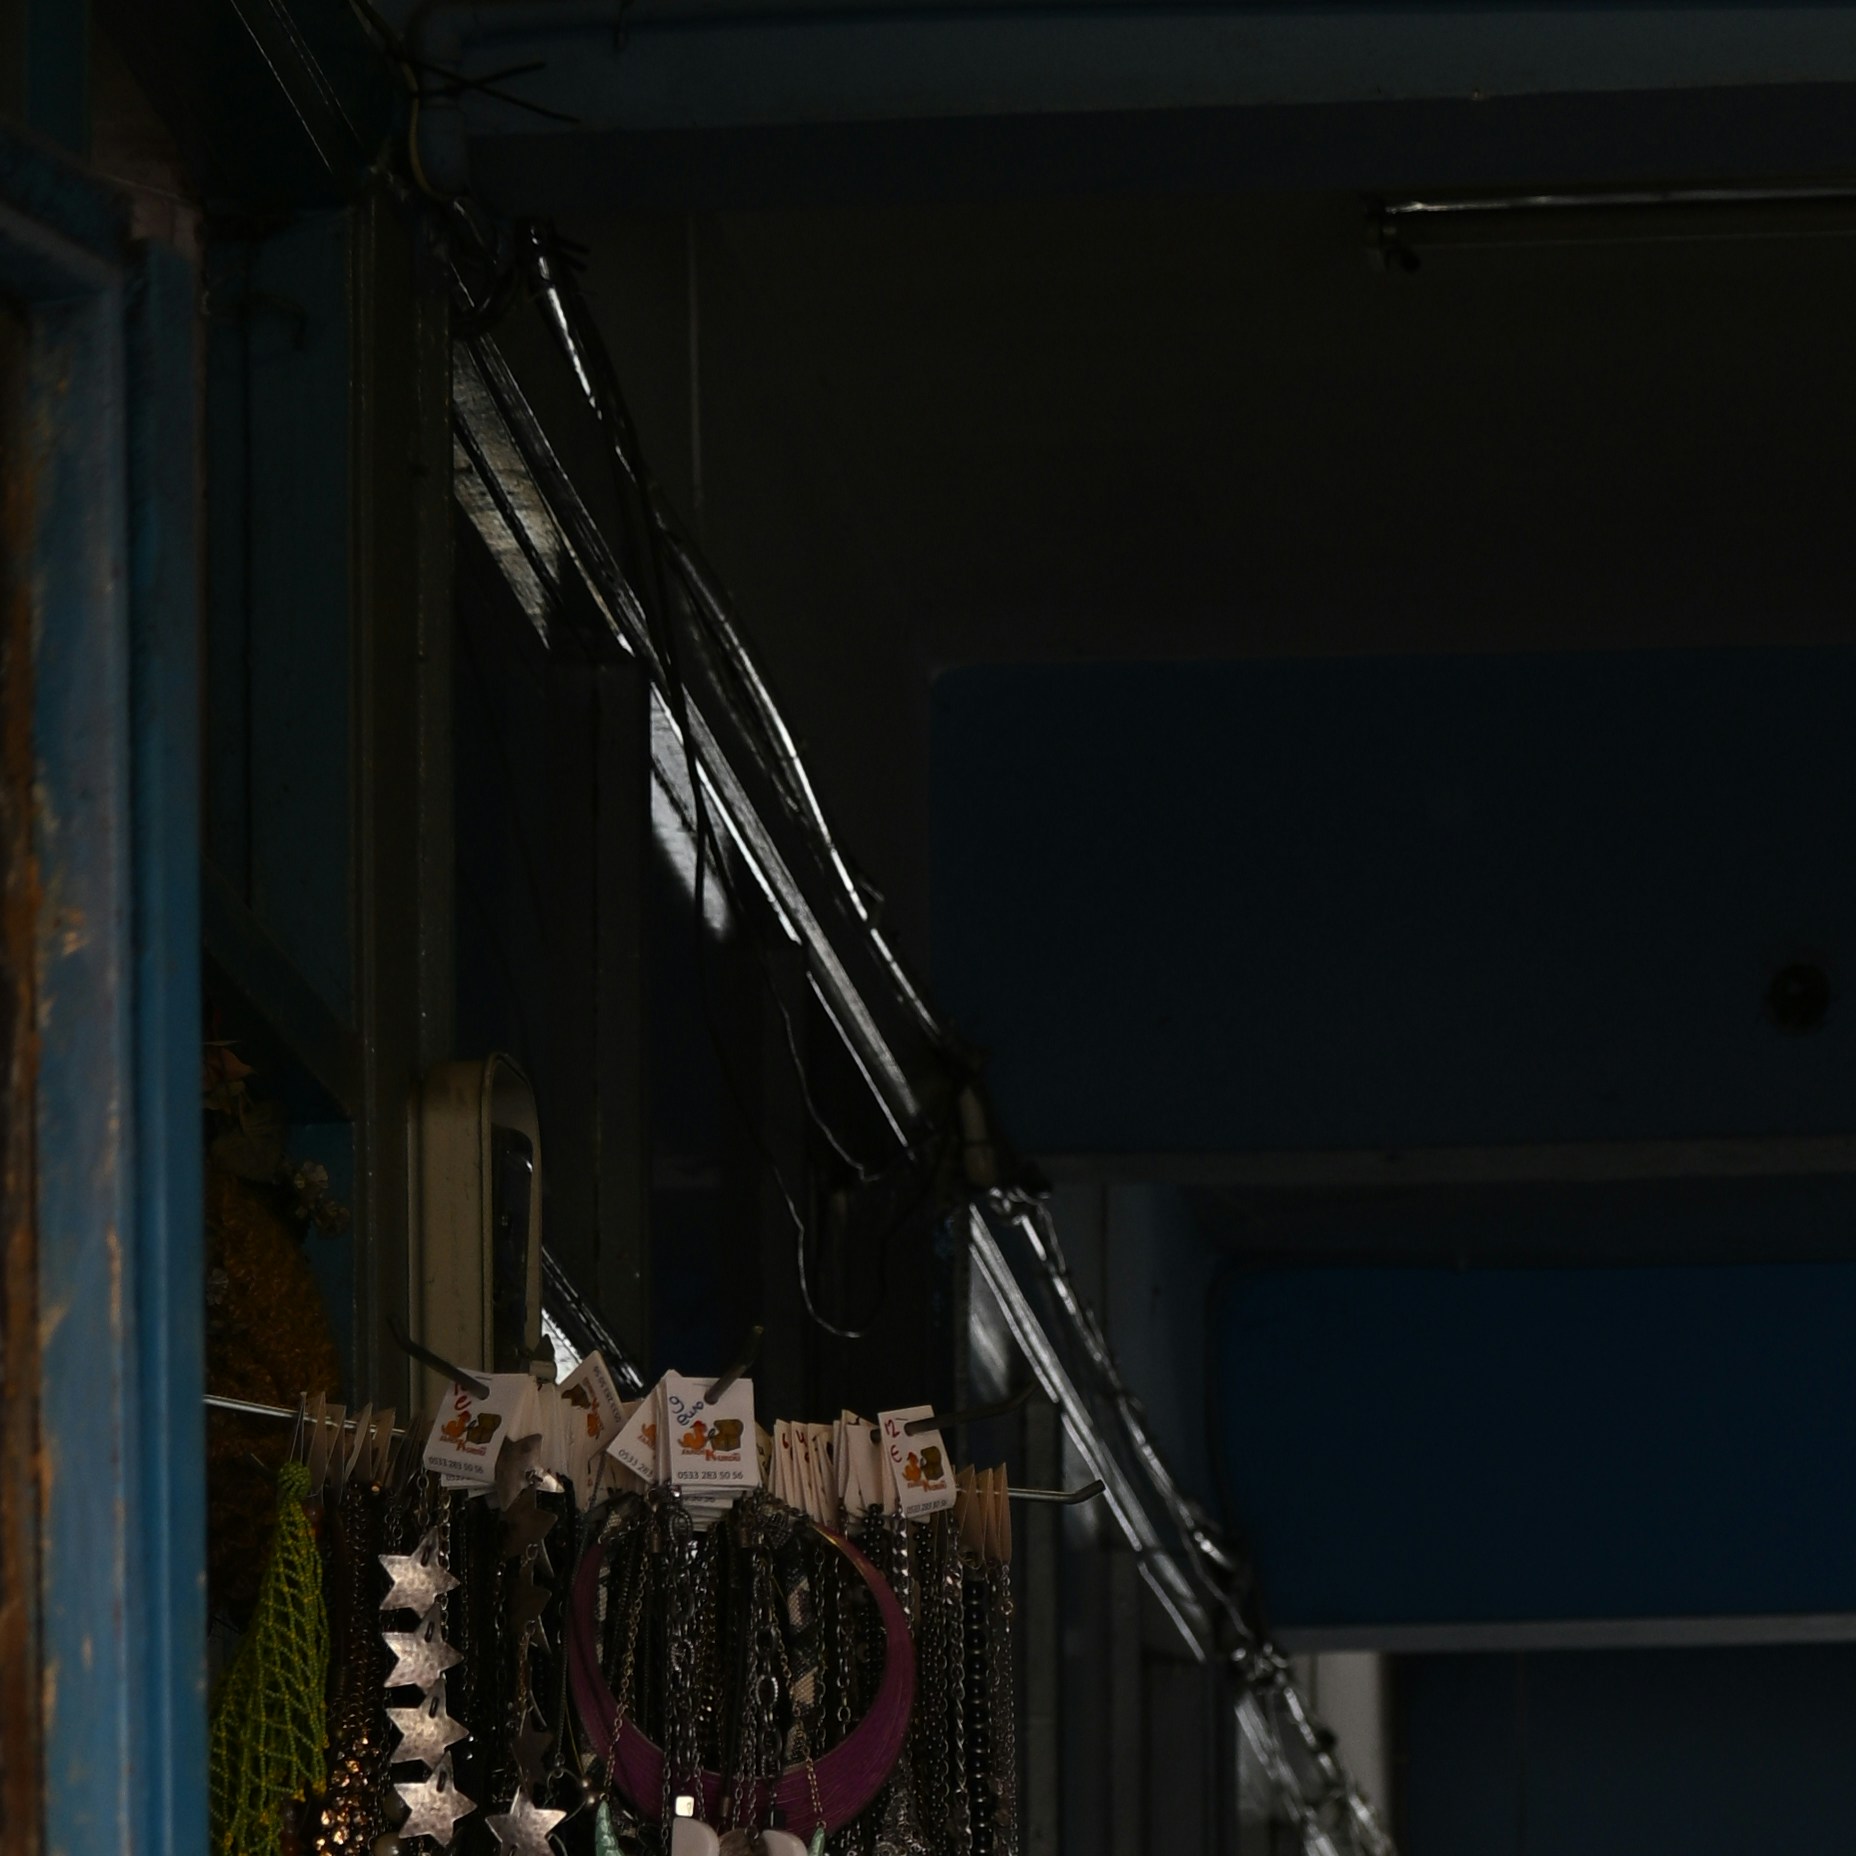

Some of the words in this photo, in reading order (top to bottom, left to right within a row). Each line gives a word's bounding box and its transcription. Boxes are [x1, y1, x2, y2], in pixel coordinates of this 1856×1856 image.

[618, 1449, 638, 1467] 0533
[678, 1471, 699, 1480] 0533
[702, 1471, 717, 1480] 283
[720, 1471, 730, 1480] 50
[732, 1471, 743, 1480] 56
